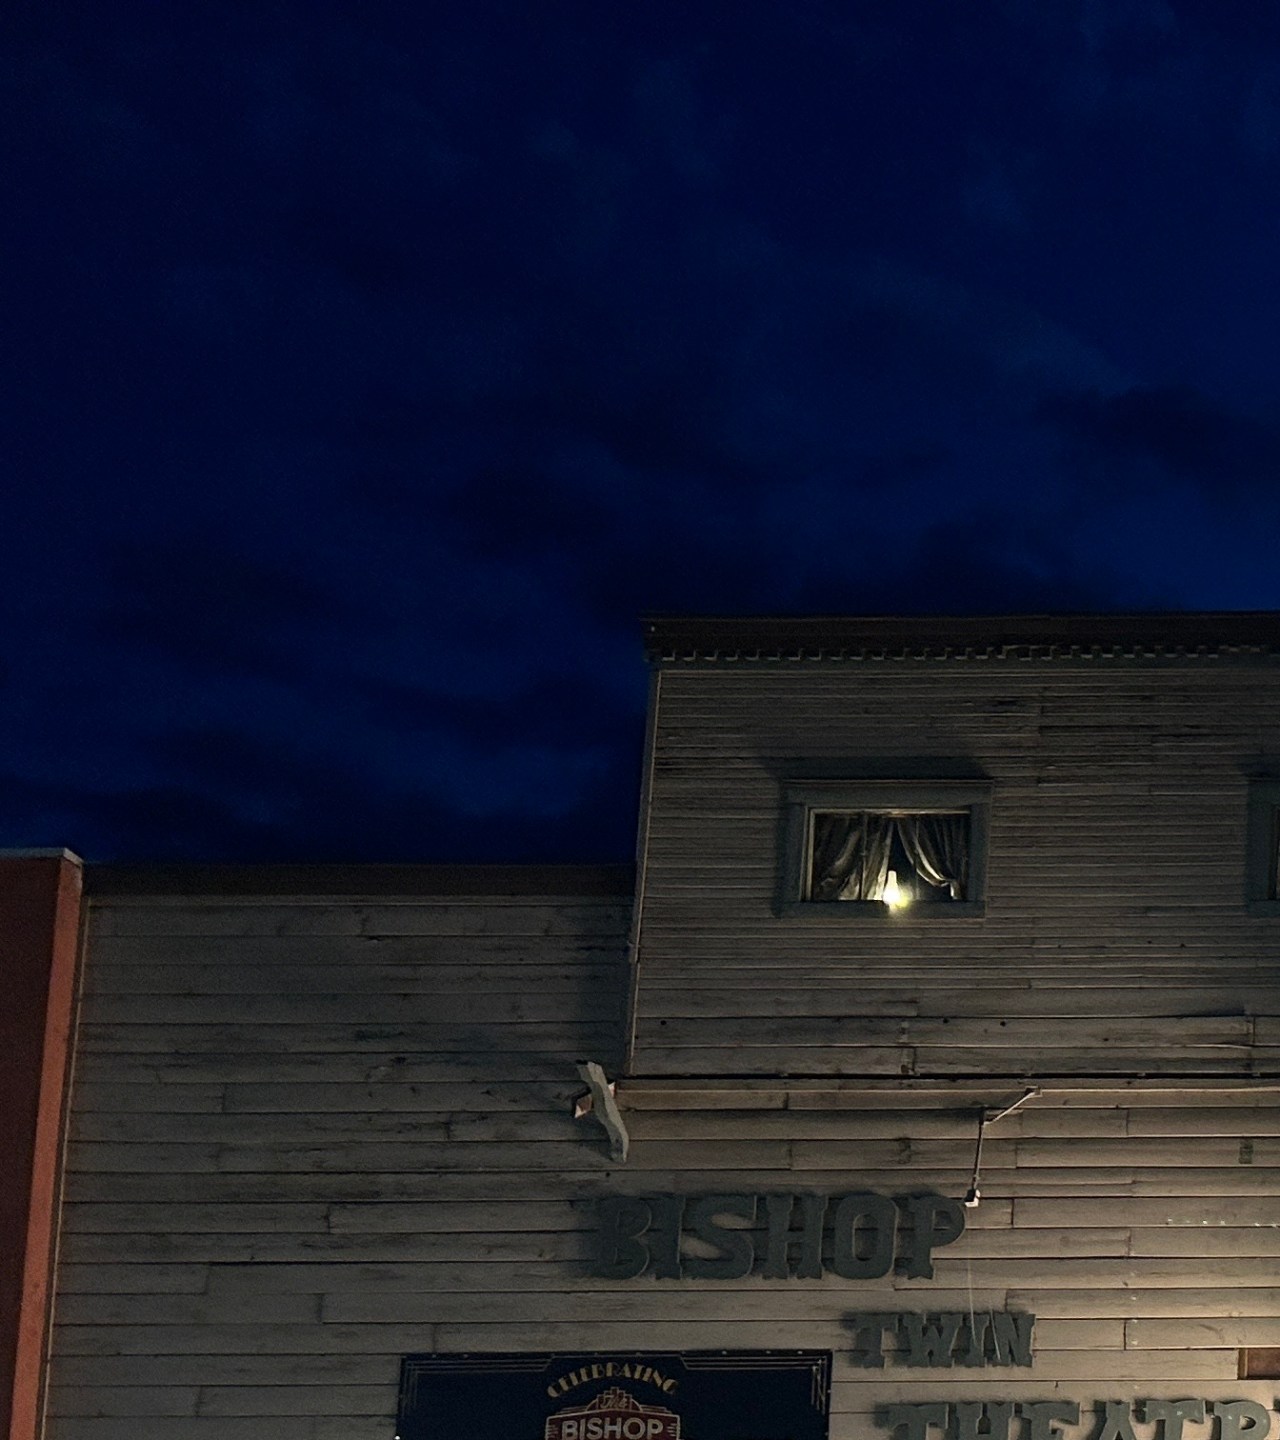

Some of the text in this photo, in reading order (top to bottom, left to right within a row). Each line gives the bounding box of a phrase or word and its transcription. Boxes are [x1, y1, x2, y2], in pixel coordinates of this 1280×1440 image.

[602, 1193, 966, 1281] BISHOP
[854, 1312, 1036, 1368] TWIN
[547, 1361, 680, 1398] CELEBRATING
